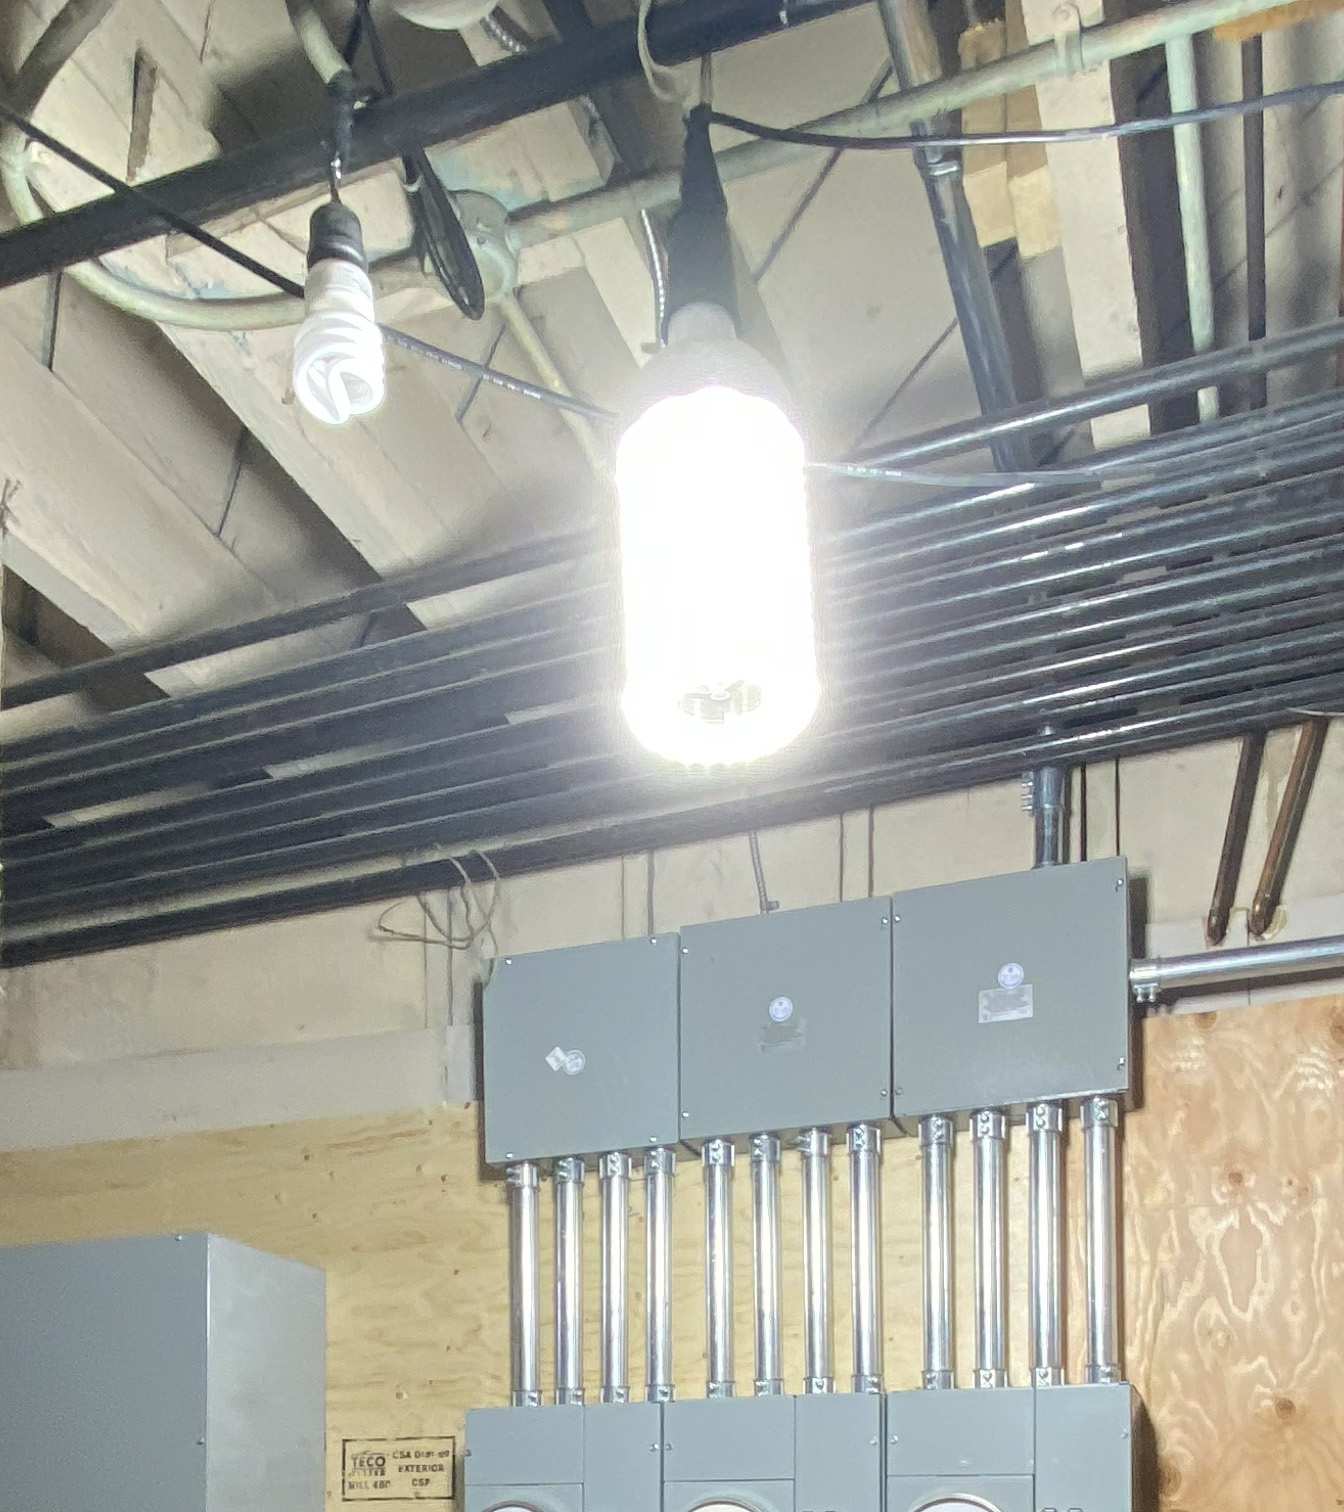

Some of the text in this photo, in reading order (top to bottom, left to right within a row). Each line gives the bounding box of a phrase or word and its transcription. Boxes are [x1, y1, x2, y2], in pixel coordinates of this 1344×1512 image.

[392, 1451, 412, 1459] CSA
[351, 1456, 386, 1468] TECO
[398, 1465, 445, 1473] EXTERIOR
[412, 1478, 431, 1487] CSP
